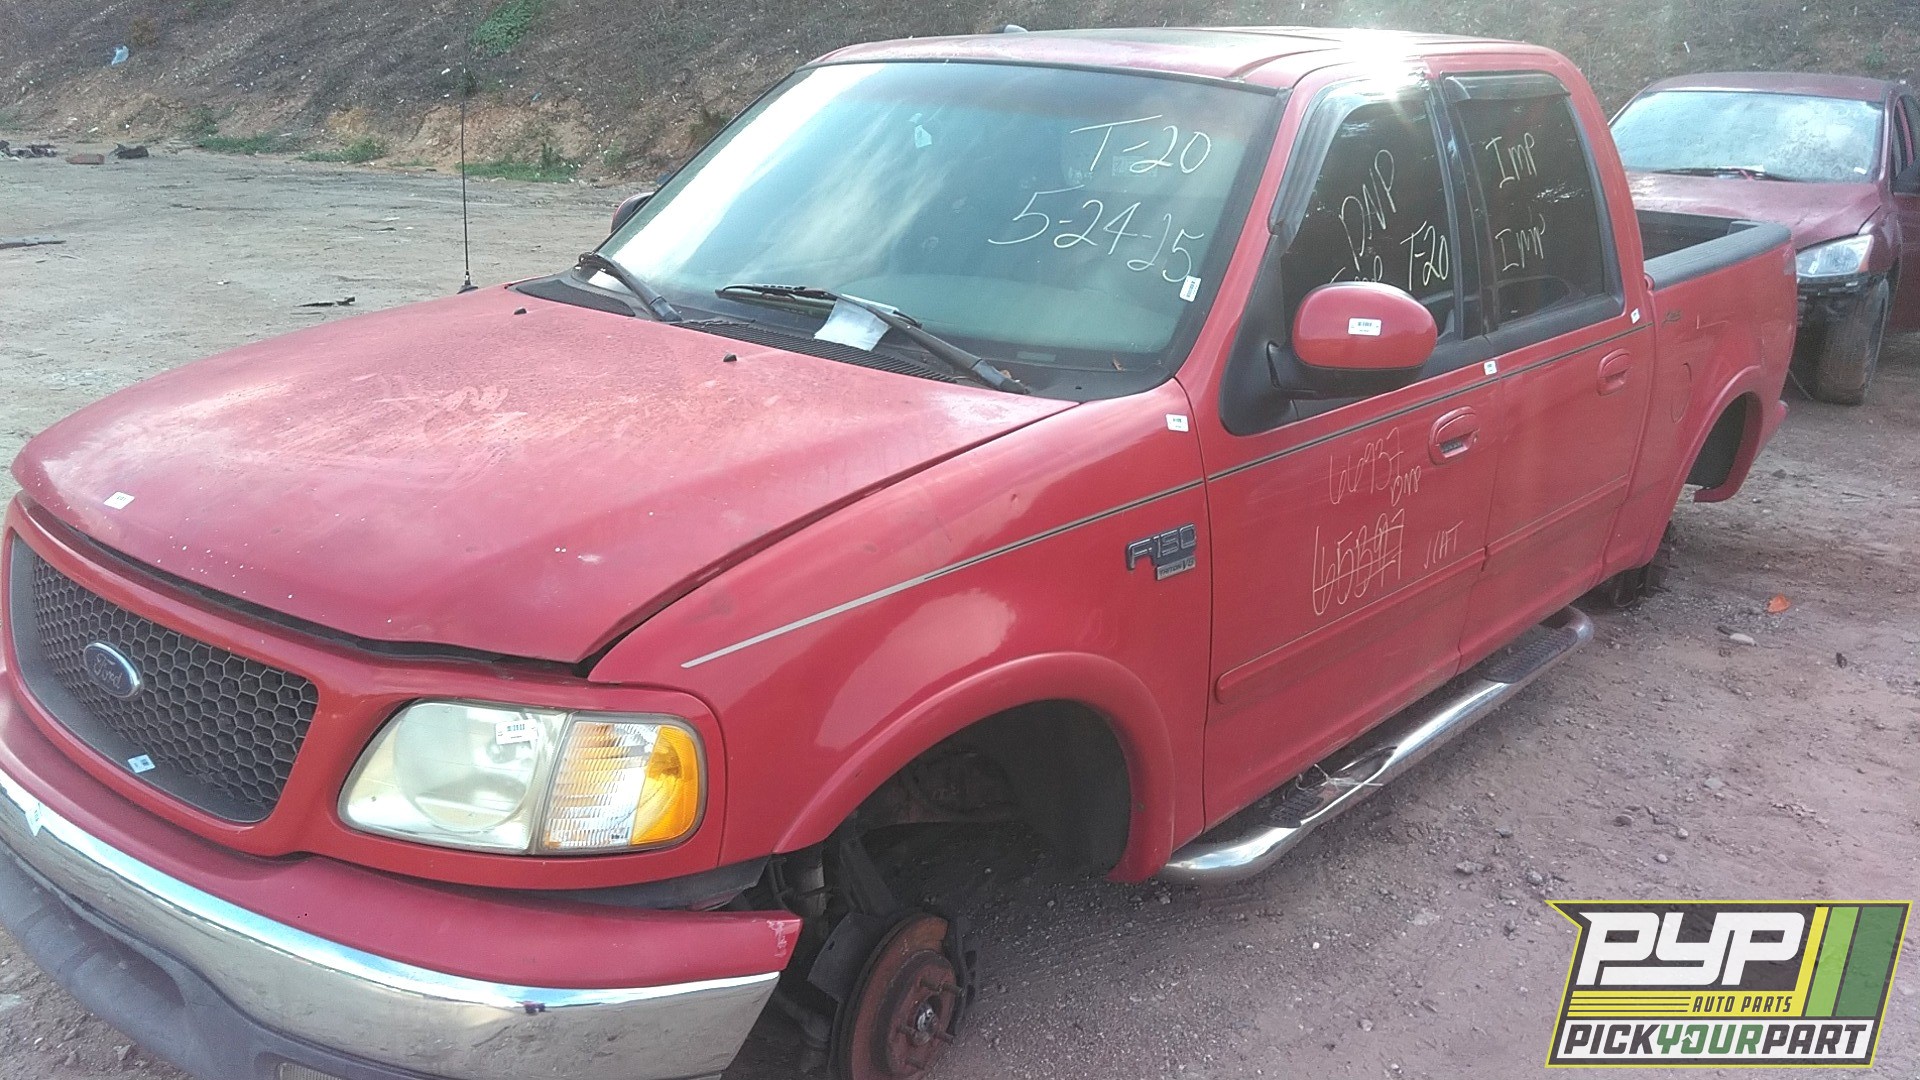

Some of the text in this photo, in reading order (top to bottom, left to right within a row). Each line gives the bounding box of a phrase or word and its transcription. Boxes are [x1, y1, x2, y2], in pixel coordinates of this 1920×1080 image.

[1069, 114, 1212, 174] T-20
[987, 184, 1205, 283] 5-24-25
[1399, 220, 1449, 292] T-20
[93, 653, 123, 690] Ford
